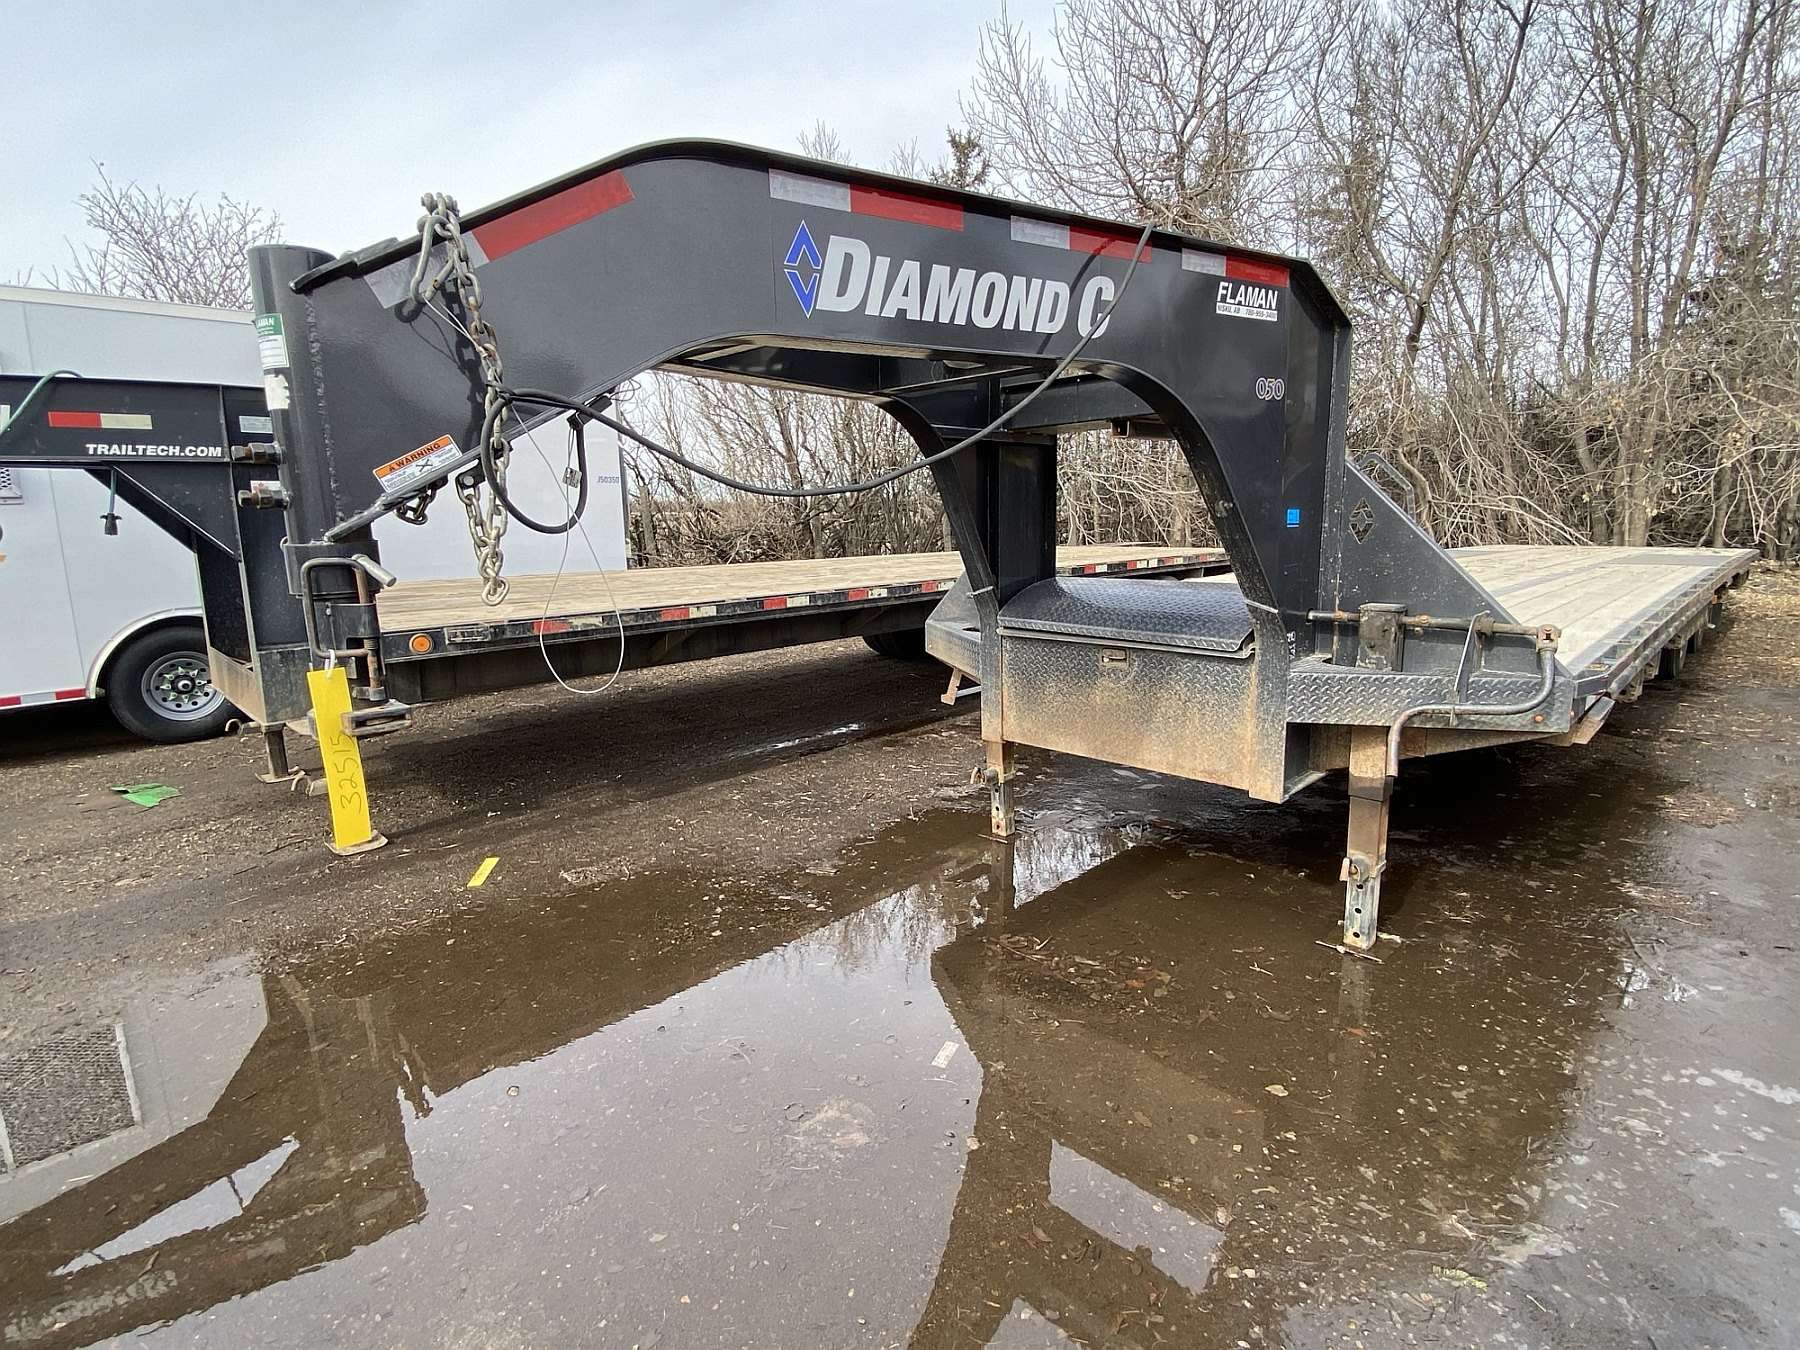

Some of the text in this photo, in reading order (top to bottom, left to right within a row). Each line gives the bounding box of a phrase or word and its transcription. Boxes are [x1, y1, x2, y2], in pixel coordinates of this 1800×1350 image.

[1077, 275, 1115, 339] C
[1217, 281, 1279, 310] FLAMAN
[1255, 377, 1285, 401] 050
[85, 443, 223, 457] TRAILTECH.COM
[395, 442, 441, 468] WARNING
[329, 734, 362, 814] 32515
